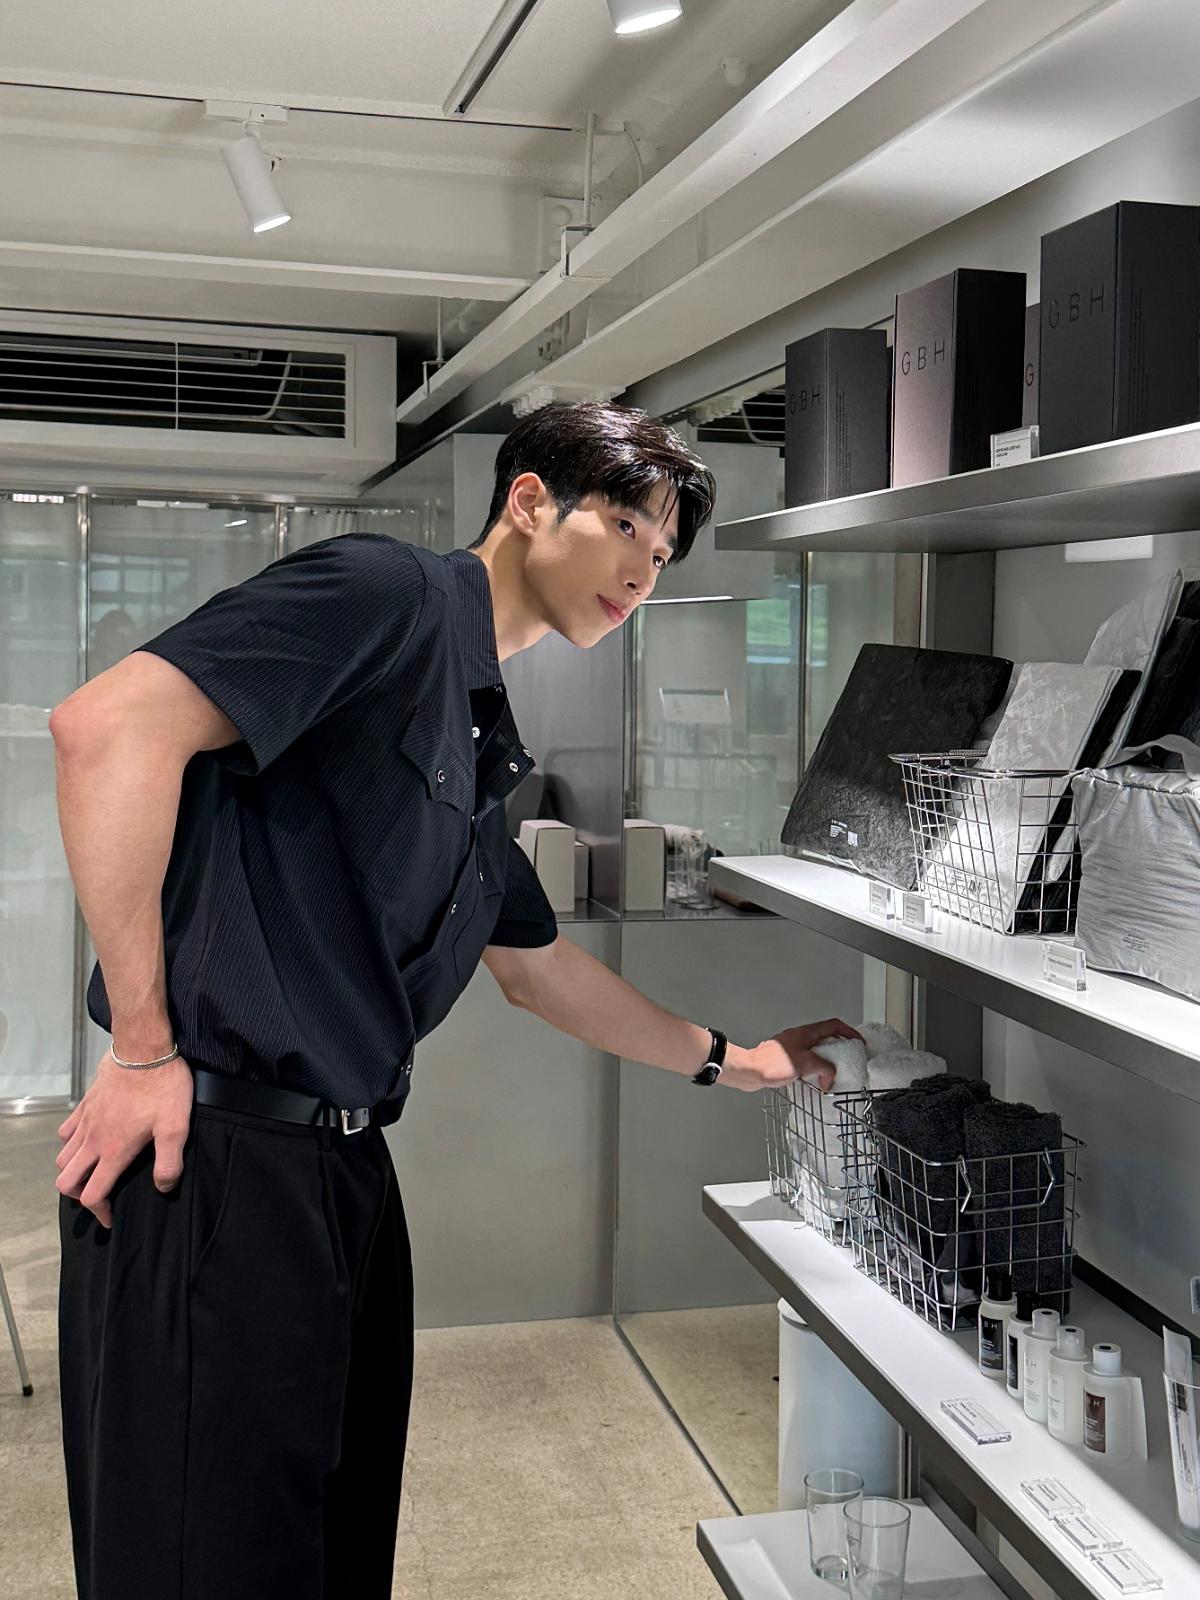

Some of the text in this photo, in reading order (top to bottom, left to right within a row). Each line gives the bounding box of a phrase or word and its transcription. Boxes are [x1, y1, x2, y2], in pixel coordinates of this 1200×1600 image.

[1048, 284, 1104, 328] GBH
[902, 339, 945, 376] GBH
[790, 384, 820, 415] GBH
